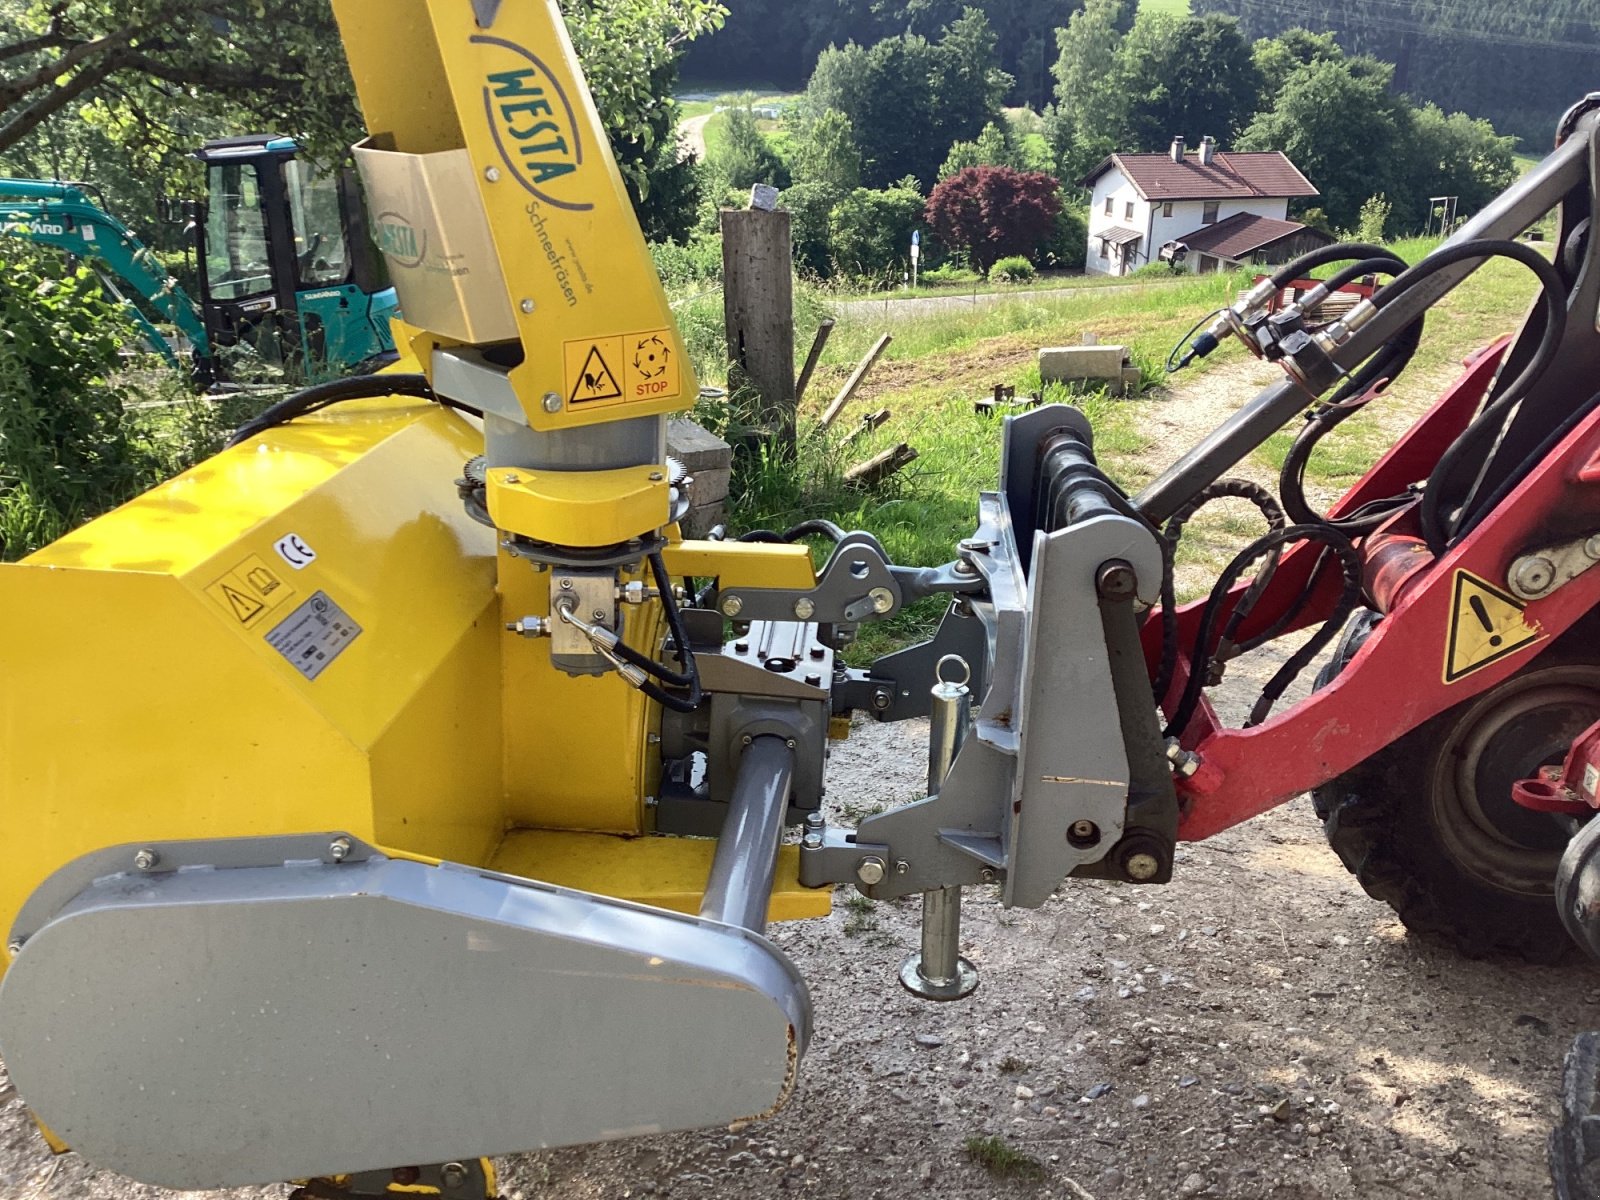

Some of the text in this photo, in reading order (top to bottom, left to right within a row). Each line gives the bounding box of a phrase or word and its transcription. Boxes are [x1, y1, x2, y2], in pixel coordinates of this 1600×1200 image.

[487, 69, 576, 184] WESTA
[525, 201, 577, 307] Schneefräsen
[636, 381, 668, 396] STOP
